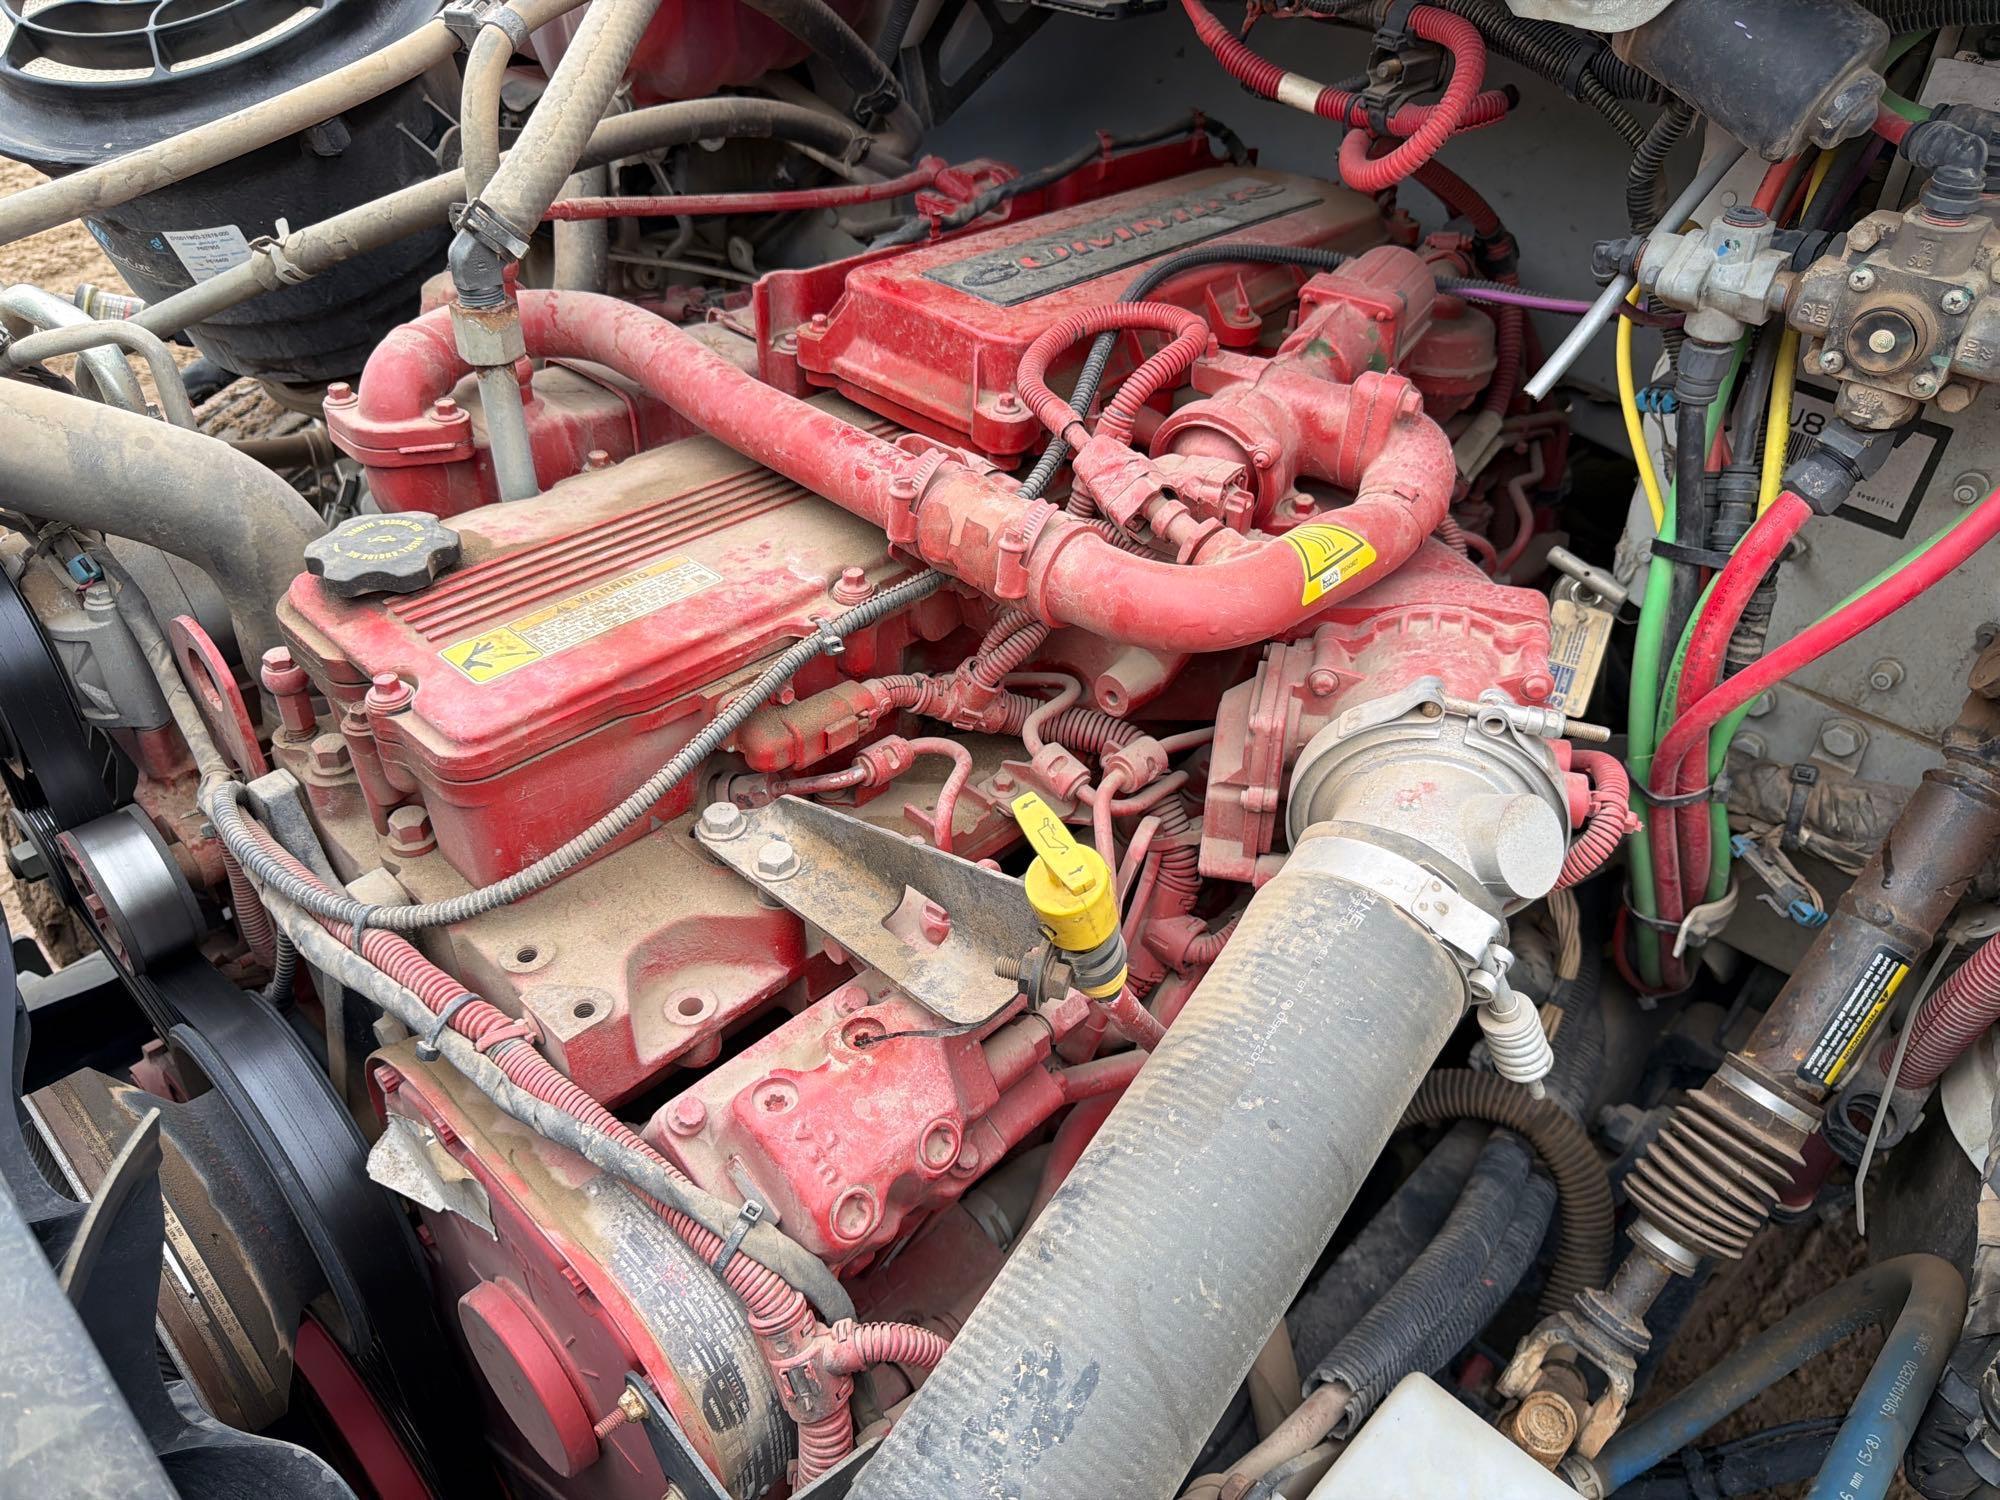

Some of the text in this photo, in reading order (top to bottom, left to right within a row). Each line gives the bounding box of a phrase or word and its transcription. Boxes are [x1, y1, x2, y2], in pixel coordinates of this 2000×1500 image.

[576, 572, 650, 606] WARNING
[183, 1253, 199, 1274] DRIVE
[653, 1311, 668, 1333] MODEL
[702, 1327, 714, 1341] TDC
[712, 1345, 726, 1364] Timing
[1855, 1434, 1882, 1467] (5/8)
[1849, 1472, 1864, 1490] mm
